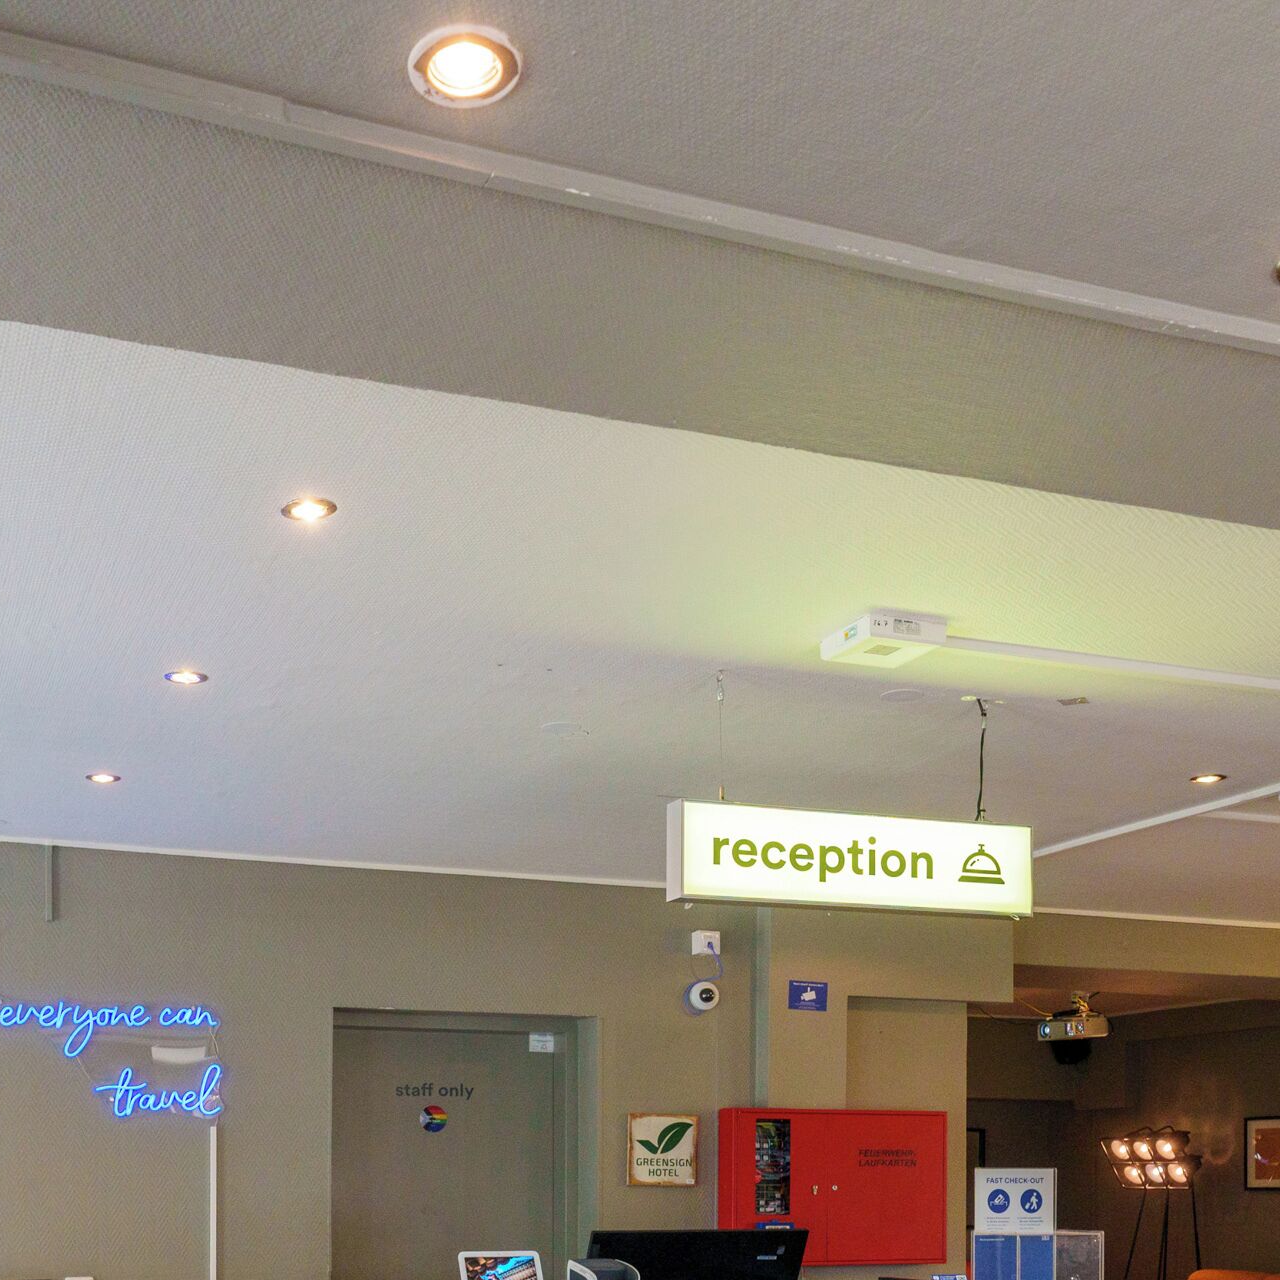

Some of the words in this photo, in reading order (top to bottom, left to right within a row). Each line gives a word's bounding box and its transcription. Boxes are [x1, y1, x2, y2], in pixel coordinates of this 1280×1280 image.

[713, 836, 933, 882] reception
[159, 1005, 218, 1027] can
[95, 1064, 222, 1117] travel
[396, 1083, 433, 1097] staff
[438, 1083, 474, 1100] only
[636, 1158, 692, 1167] GREENSIGN
[859, 1159, 917, 1168] LAUFKARTEN
[648, 1168, 679, 1177] HOTEL
